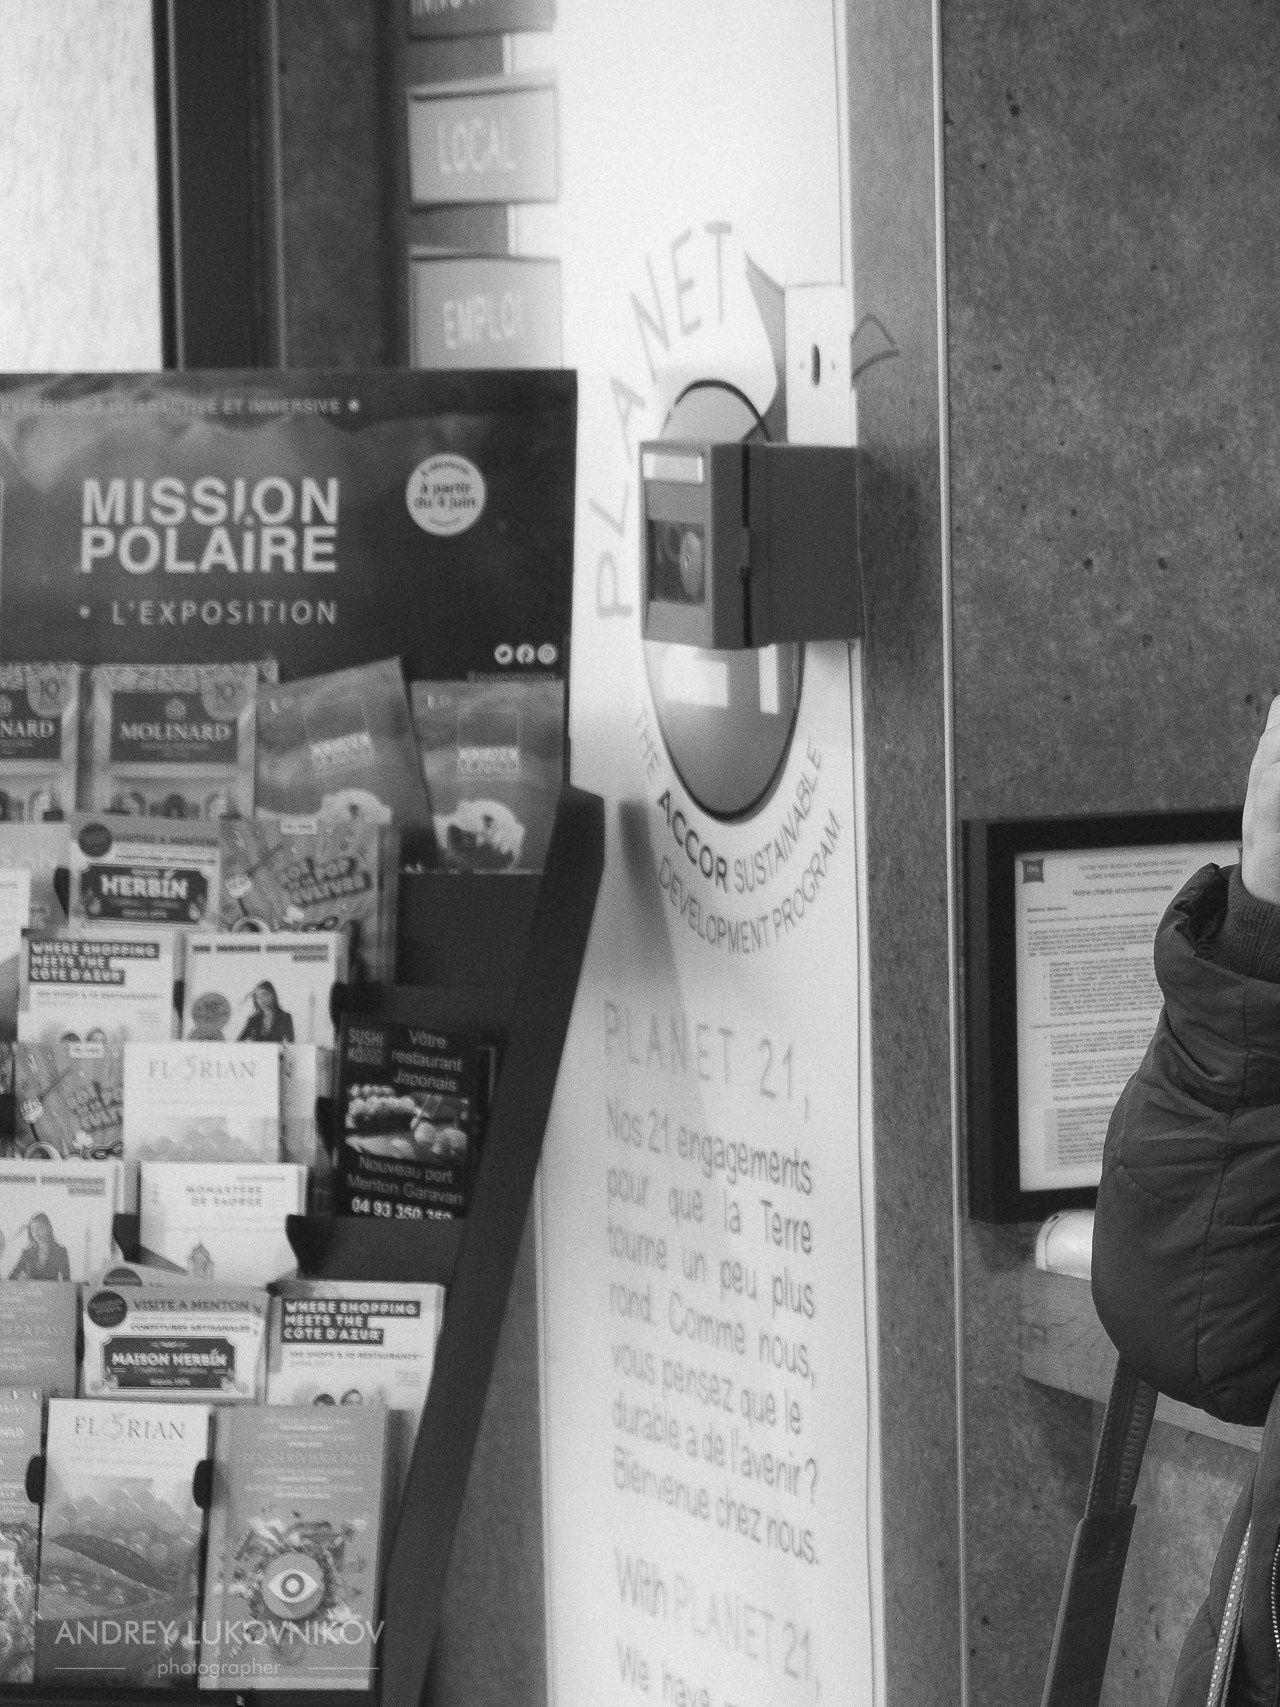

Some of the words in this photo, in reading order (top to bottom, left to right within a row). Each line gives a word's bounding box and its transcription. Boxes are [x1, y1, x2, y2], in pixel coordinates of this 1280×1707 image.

[82, 476, 340, 526] MISSION
[111, 601, 338, 626] L'EXPOSITION
[0, 719, 55, 741] NARD
[120, 721, 232, 742] MOLINARD
[656, 788, 729, 895] ACCOR
[733, 737, 823, 895] SUSTAINABLE
[101, 874, 188, 899] HERBIN
[658, 855, 770, 956] DEVELOPMENT
[772, 808, 842, 942] PROGRAM
[31, 955, 75, 968] MEETS
[78, 956, 106, 969] THE
[348, 1027, 387, 1047] SUSHI
[603, 1001, 735, 1085] PLANET
[391, 1050, 464, 1073] restaurant
[393, 1069, 459, 1092] Japonais
[606, 1097, 643, 1149] Nos
[648, 1109, 670, 1155] 21
[677, 1124, 813, 1197] engagements
[358, 1155, 422, 1179] Nouveau
[424, 1169, 454, 1185] port
[347, 1173, 400, 1195] Menton
[402, 1182, 465, 1205] Garavan
[606, 1166, 649, 1209] pour
[668, 1186, 705, 1226] que
[723, 1188, 742, 1235] la
[759, 1198, 813, 1256] Terre
[606, 1219, 669, 1272] tourne
[681, 1250, 708, 1284] un
[719, 1259, 758, 1303] peu
[771, 1266, 816, 1321] plus
[132, 1298, 175, 1312] VISITE
[190, 1300, 249, 1313] MENTON
[285, 1301, 337, 1314] WHERE
[339, 1302, 418, 1316] SHOPPING
[284, 1314, 332, 1327] MEETS
[335, 1315, 364, 1328] THE
[668, 1290, 746, 1357] Comme
[758, 1331, 815, 1391] nous,
[111, 1353, 170, 1367] MAISON
[172, 1352, 227, 1367] HERBIN
[611, 1344, 656, 1386] vous
[661, 1359, 733, 1414] pensez
[740, 1389, 777, 1432] que
[784, 1388, 802, 1436] le
[612, 1390, 680, 1452] durable
[685, 1426, 699, 1459] a
[701, 1422, 726, 1468] de
[613, 1444, 710, 1522] Bienvenue
[715, 1487, 762, 1546] chez
[766, 1509, 822, 1568] nous.
